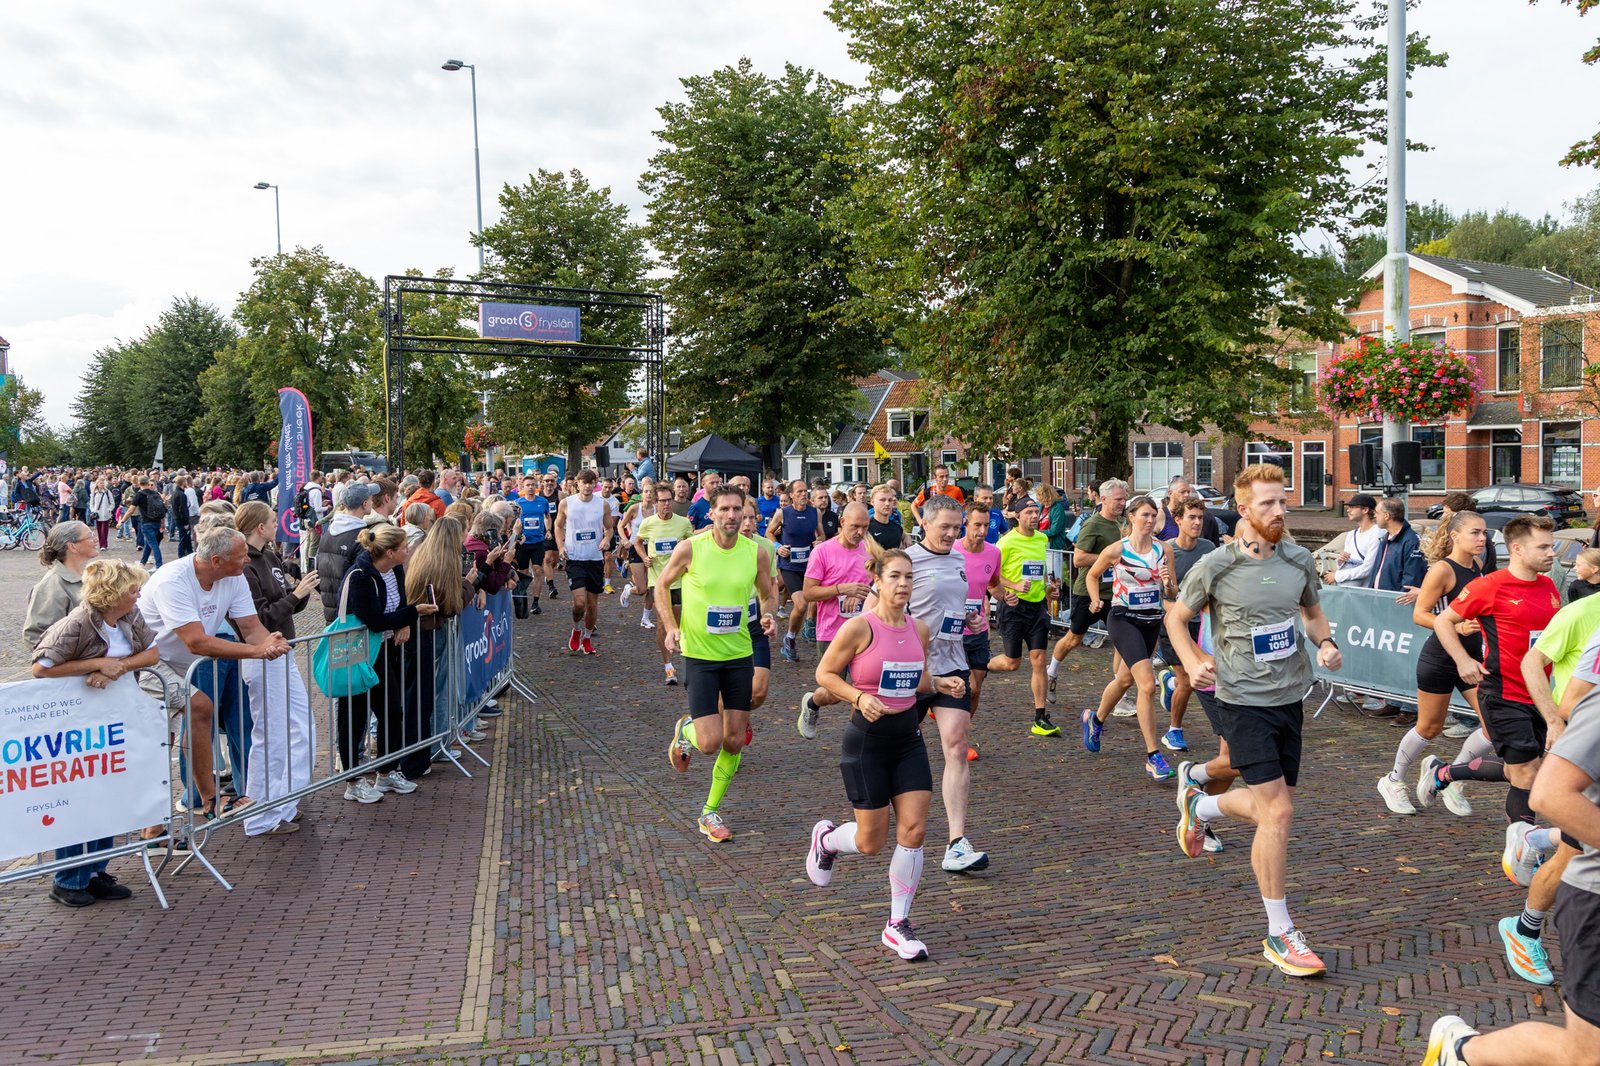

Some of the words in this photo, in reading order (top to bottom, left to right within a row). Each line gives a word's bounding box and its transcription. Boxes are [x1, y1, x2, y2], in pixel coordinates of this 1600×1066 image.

[488, 316, 518, 328] groot
[1269, 631, 1288, 642] JELLE
[1347, 625, 1414, 654] CARE
[1268, 638, 1290, 651] 1096
[895, 679, 911, 688] 566
[4, 703, 40, 715] SAMEN
[42, 701, 57, 710] OP
[59, 698, 82, 708] WEG
[19, 712, 47, 722] NAAR
[49, 709, 69, 718] EEN
[2, 722, 125, 764] OKVRIJE
[0, 750, 127, 795] NERATIE
